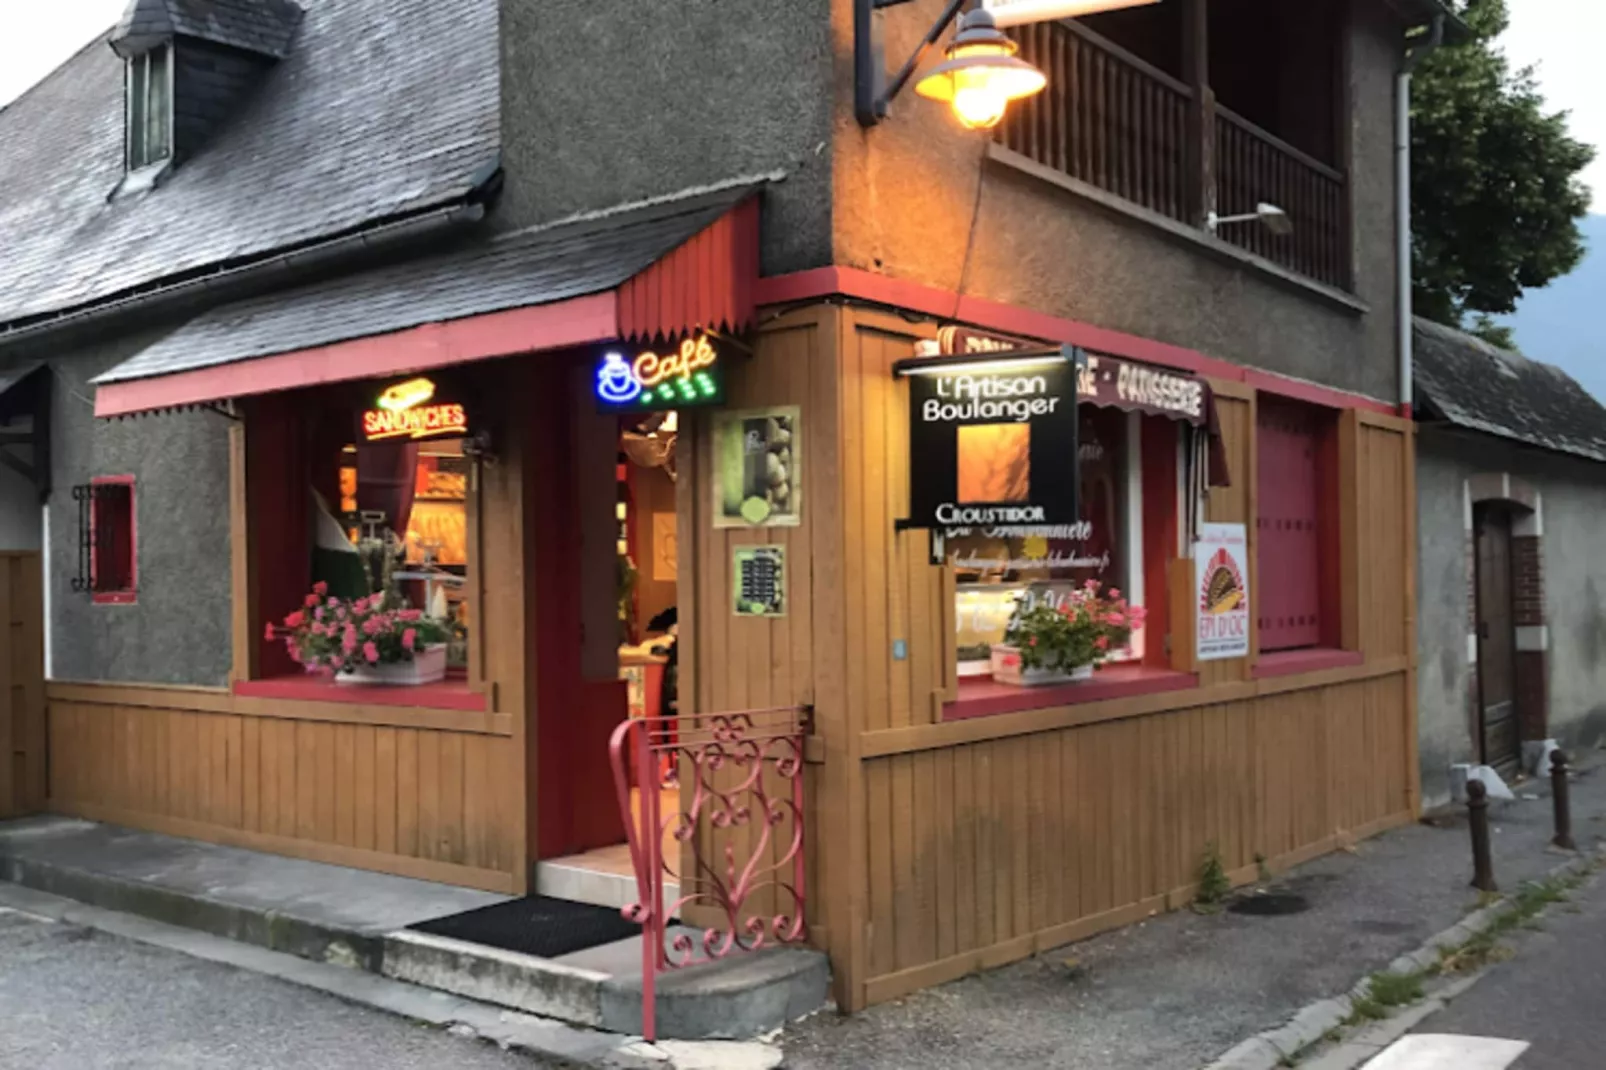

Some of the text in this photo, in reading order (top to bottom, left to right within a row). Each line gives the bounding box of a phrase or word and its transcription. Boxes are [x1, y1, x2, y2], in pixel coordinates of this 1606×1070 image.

[632, 335, 717, 385] Café
[923, 396, 1060, 422] Boulanger
[1118, 363, 1202, 416] PATISSERIE
